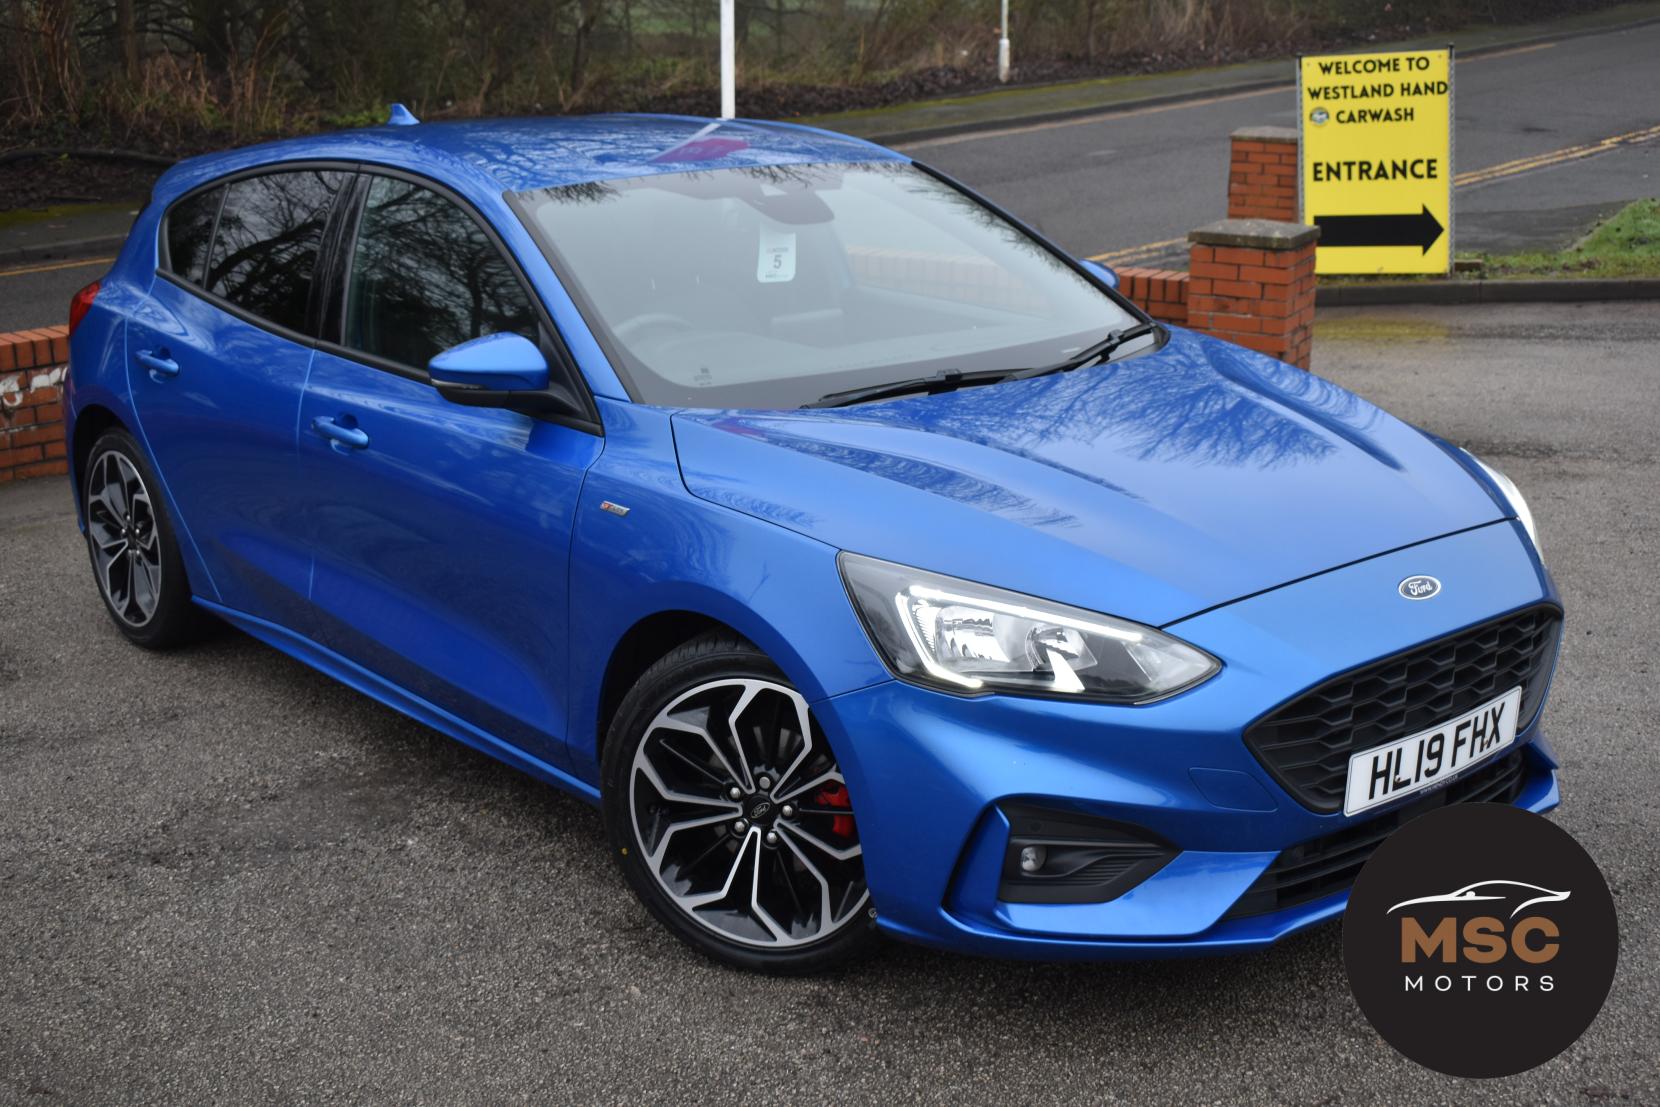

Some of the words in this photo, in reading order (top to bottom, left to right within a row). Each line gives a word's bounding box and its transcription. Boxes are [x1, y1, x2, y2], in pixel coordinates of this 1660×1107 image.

[1318, 57, 1400, 75] WELCOME
[1405, 56, 1430, 71] TO
[1307, 84, 1394, 100] WESTLAND
[1400, 81, 1449, 97] HAND
[1336, 107, 1415, 124] CARWASH
[1312, 159, 1438, 182] ENTRANCE
[772, 253, 783, 270] 5
[1408, 580, 1433, 596] Ford
[1368, 733, 1445, 800] HL19
[1450, 701, 1506, 768] FHX
